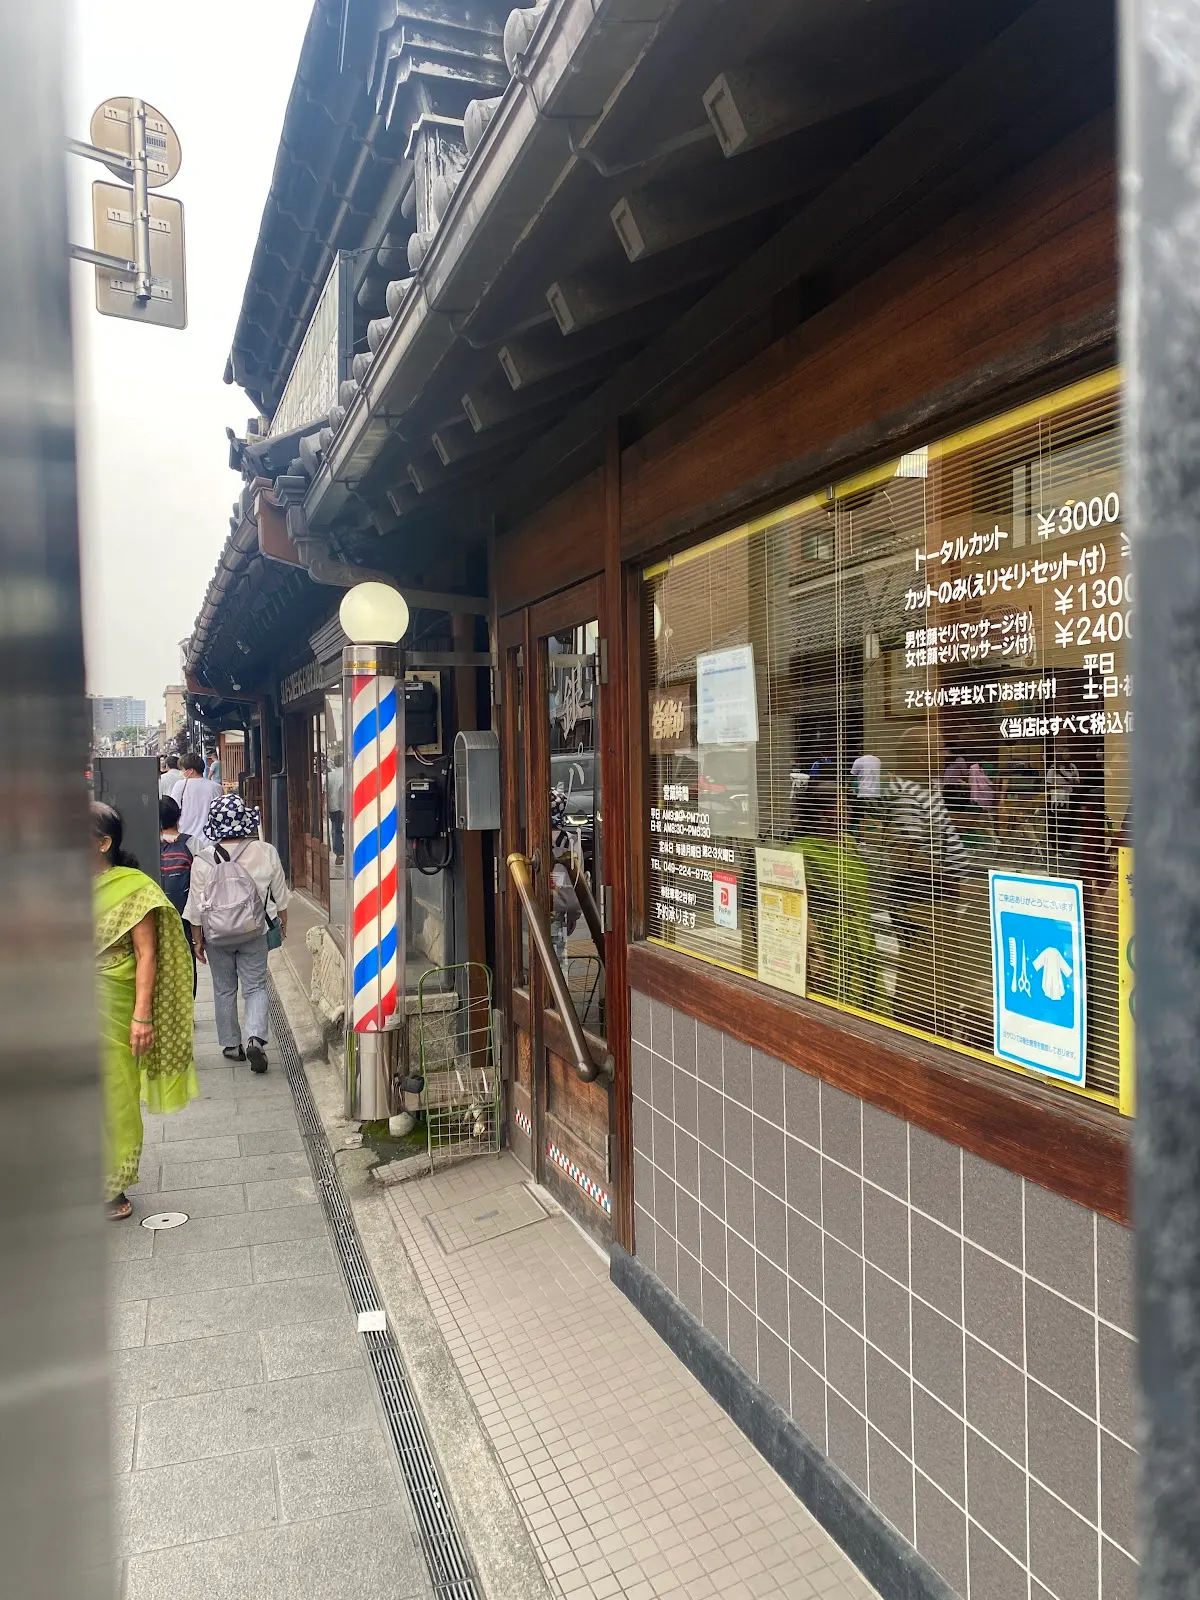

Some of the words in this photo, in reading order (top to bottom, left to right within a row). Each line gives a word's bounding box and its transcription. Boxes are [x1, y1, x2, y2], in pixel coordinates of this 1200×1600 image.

[915, 524, 1009, 572] トータルカット
[1037, 492, 1119, 540] ¥3000
[1083, 652, 1115, 676] 平日
[904, 677, 1057, 709] 子ども(小学生以下)おまけ付!
[652, 699, 684, 739] 営業中
[663, 784, 689, 802] 営業時間
[650, 858, 662, 870] TEL
[998, 893, 1074, 912] ご来店ありがとうございます
[655, 902, 697, 929] 予約承ります
